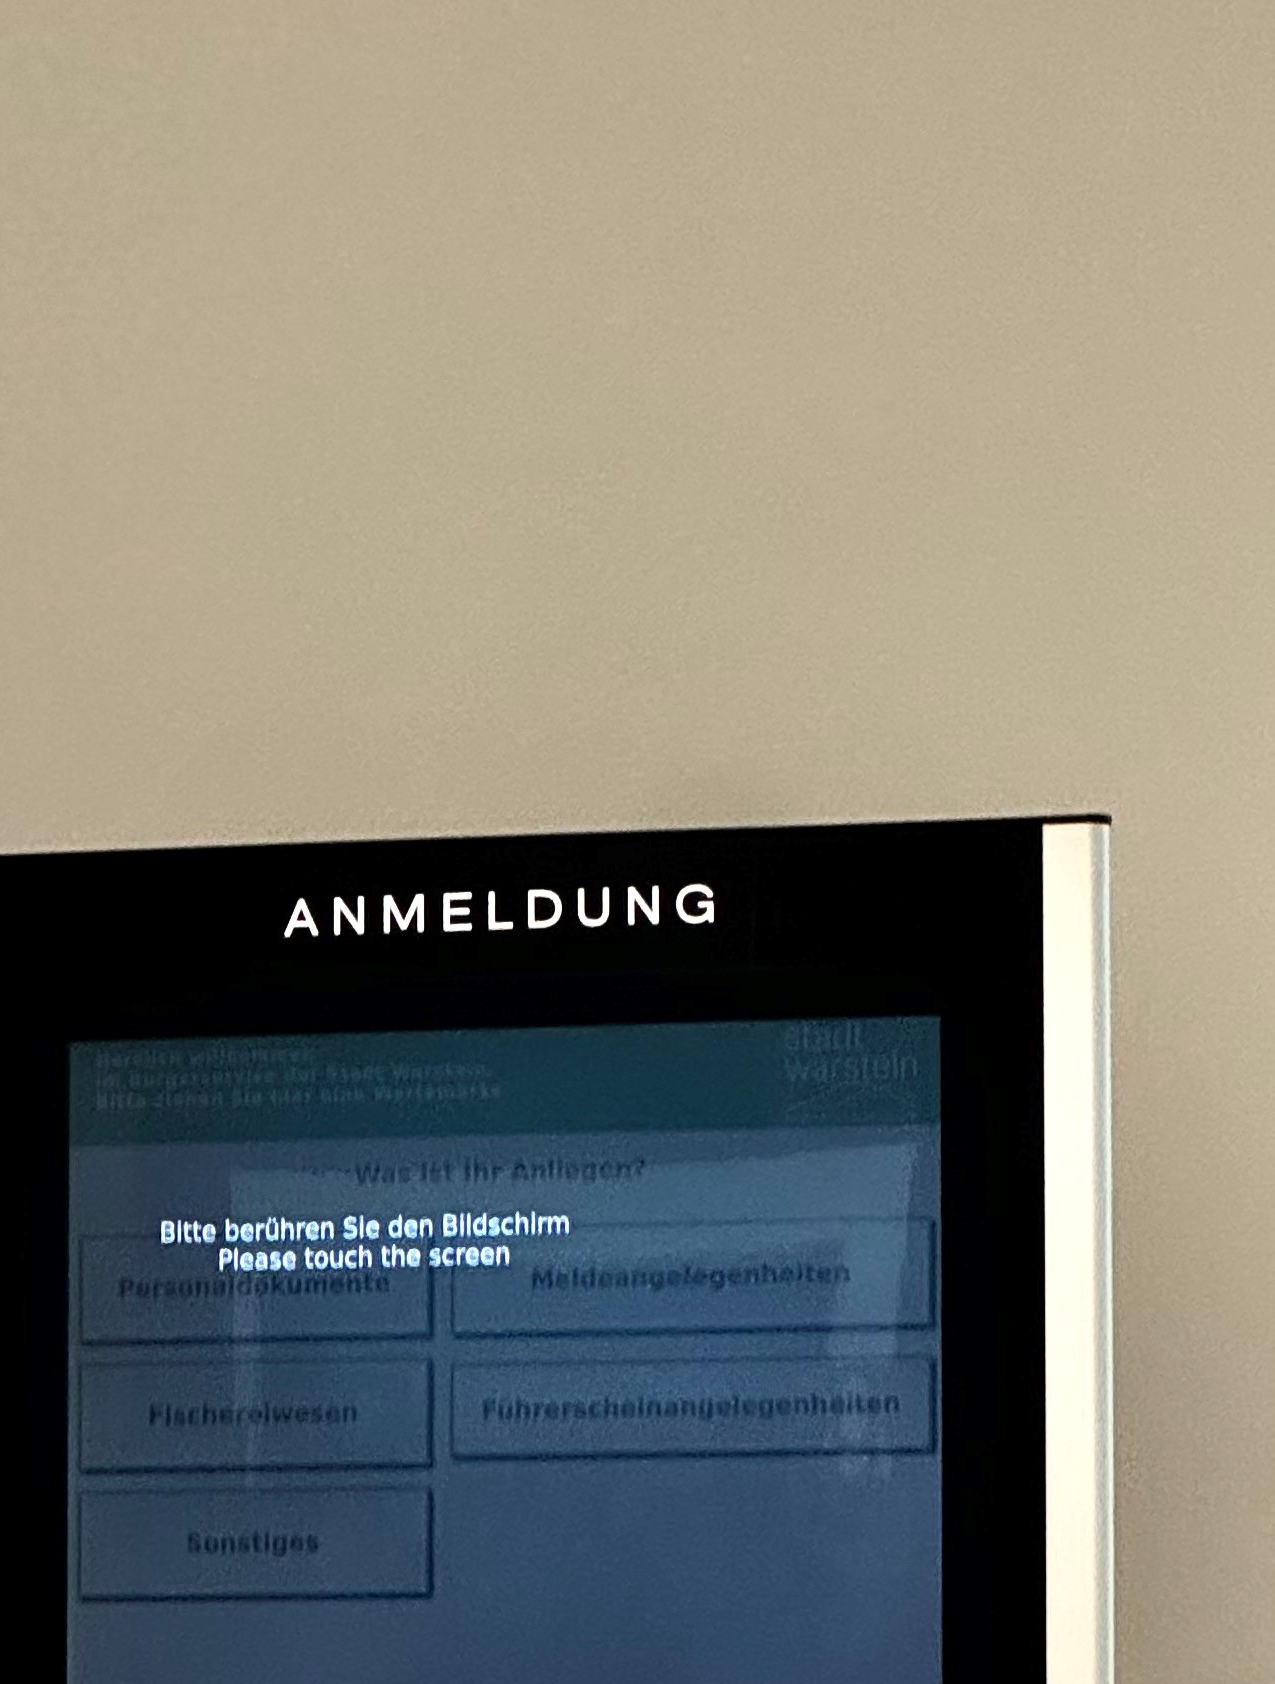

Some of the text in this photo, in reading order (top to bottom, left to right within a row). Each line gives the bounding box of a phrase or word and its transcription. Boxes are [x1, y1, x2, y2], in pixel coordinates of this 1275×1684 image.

[283, 883, 715, 938] ANMELDUNG
[355, 1162, 412, 1185] Was
[464, 1159, 502, 1183] Ihr
[160, 1210, 571, 1245] Bitte berühren Sie den Bildschirm
[218, 1242, 511, 1272] Please touch the screen
[531, 1261, 851, 1293] Meldeangelegenheiten
[148, 1400, 358, 1428] Fischereiwesen
[481, 1391, 900, 1424] Führerscheinangelegenheiten
[187, 1530, 320, 1558] Sonstiges
